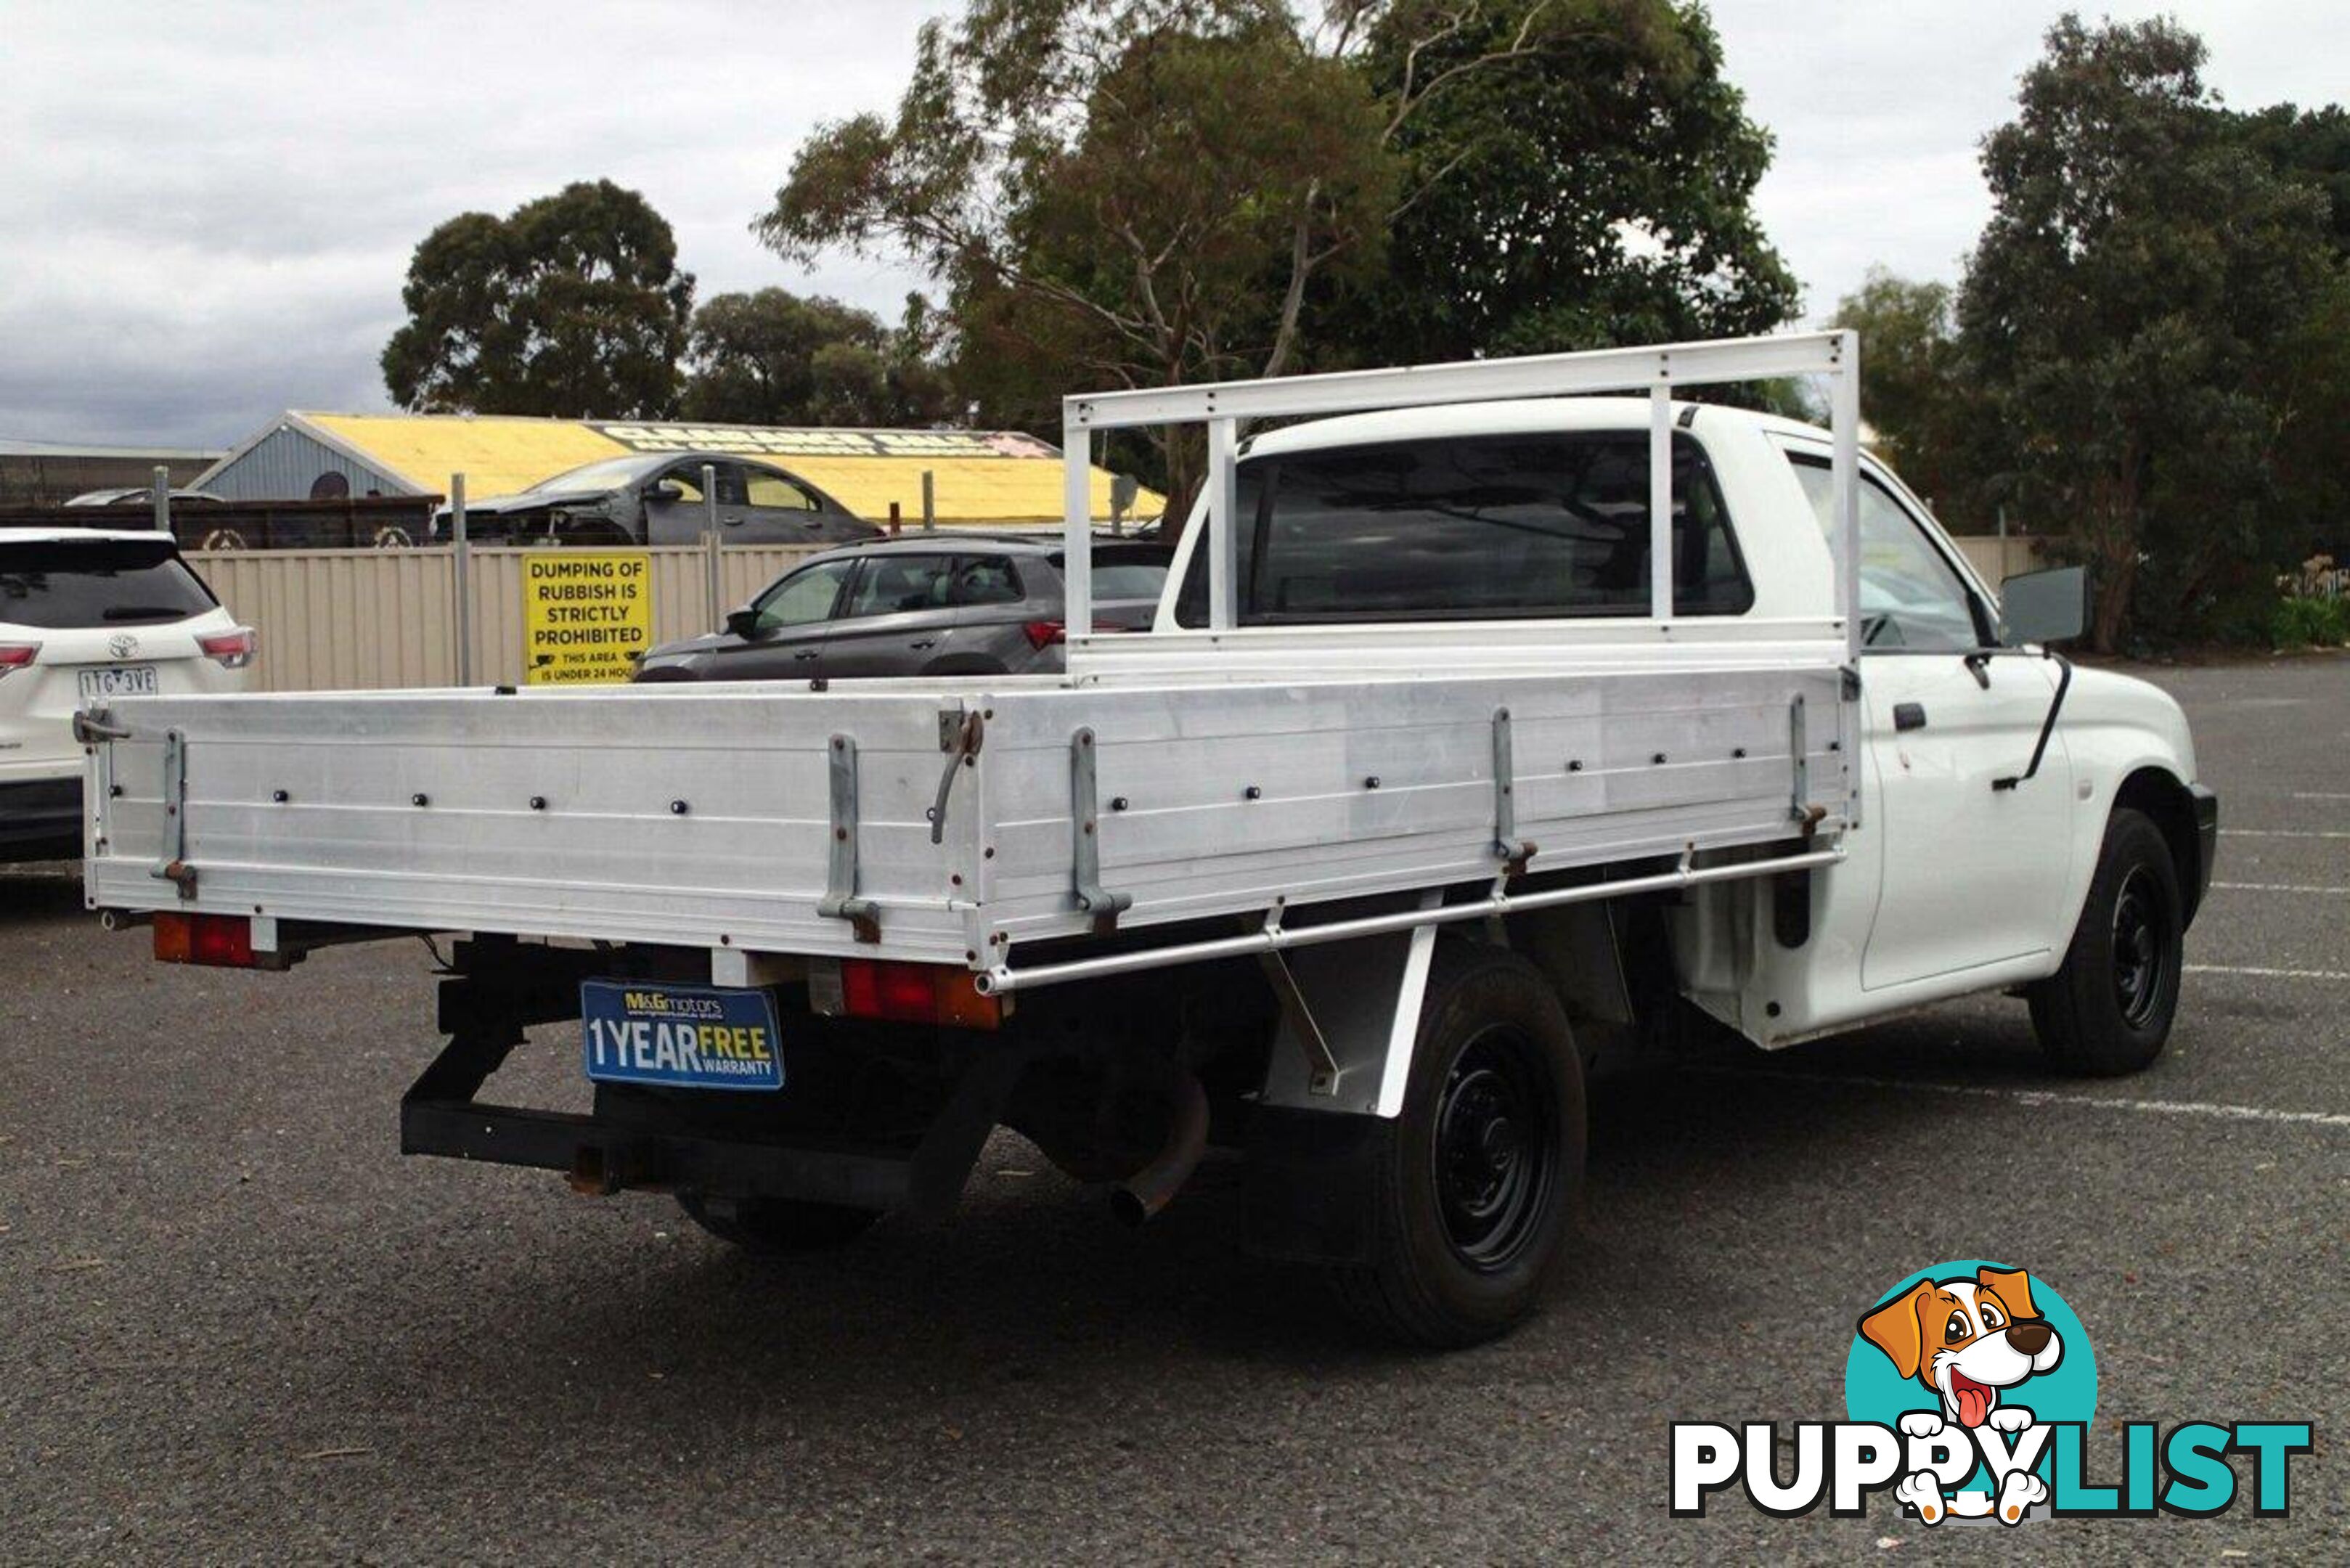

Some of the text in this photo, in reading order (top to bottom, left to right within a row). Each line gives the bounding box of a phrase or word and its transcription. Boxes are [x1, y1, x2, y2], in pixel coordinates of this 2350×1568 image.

[531, 562, 642, 579] DUMPING OF
[539, 584, 637, 600] RUBBISH IS
[547, 605, 629, 623] STRICTLY
[535, 627, 642, 645] PROHIBITED
[563, 652, 617, 663] THIS AREA
[542, 670, 551, 681] IS
[554, 669, 590, 680] UNDER
[594, 668, 606, 679] 24
[589, 1018, 770, 1073] 1 YEAR FREE
[702, 1058, 772, 1076] WARRANTY
